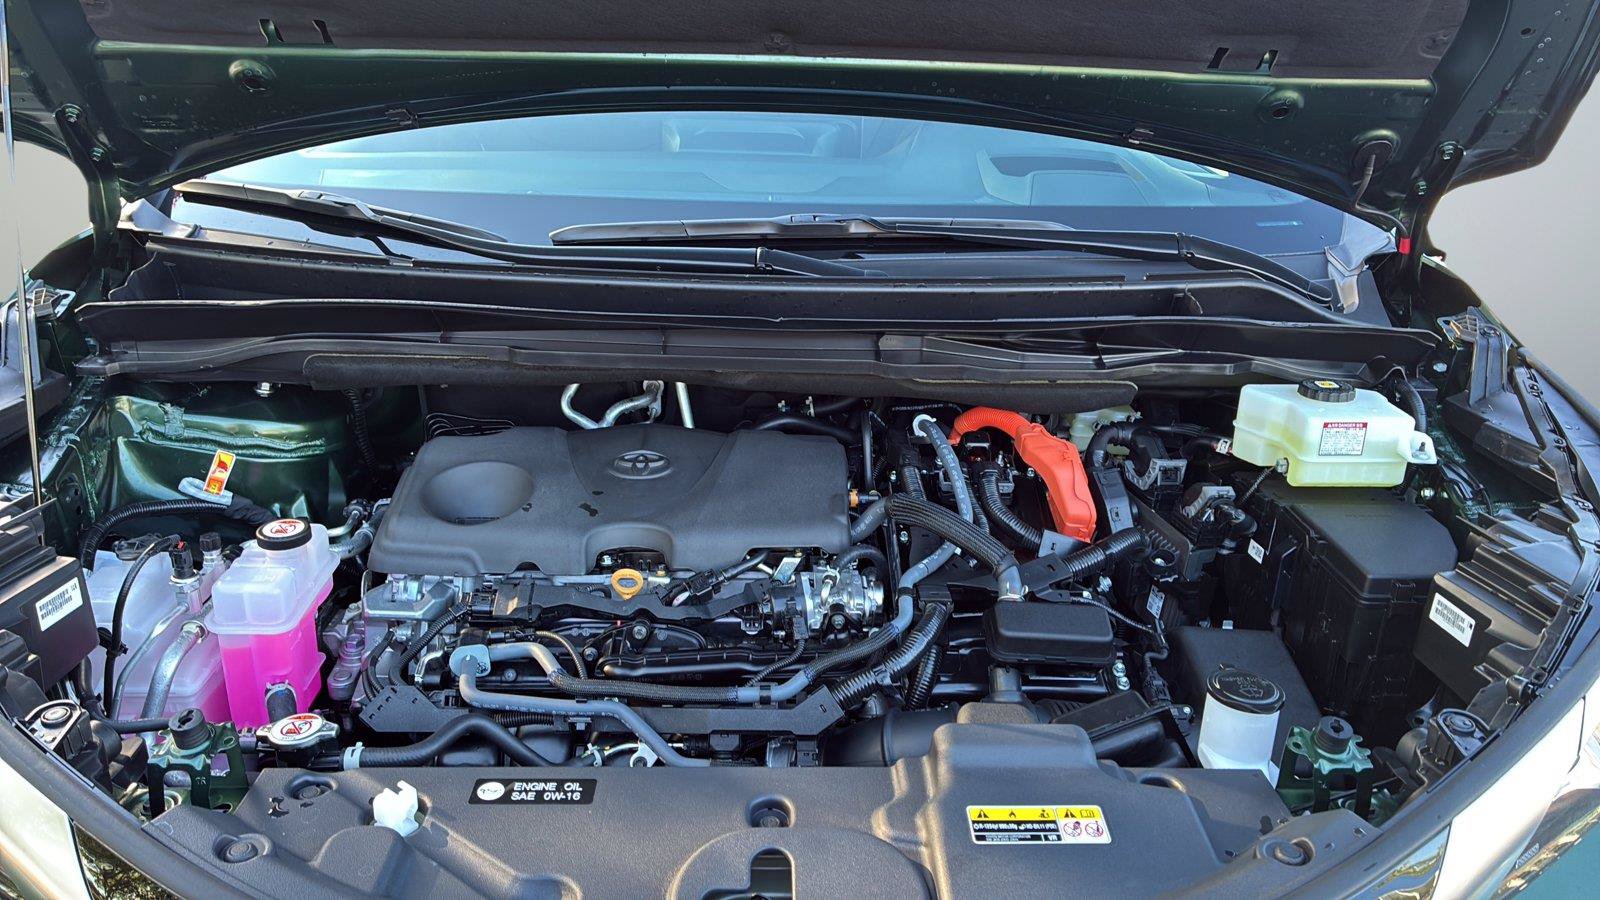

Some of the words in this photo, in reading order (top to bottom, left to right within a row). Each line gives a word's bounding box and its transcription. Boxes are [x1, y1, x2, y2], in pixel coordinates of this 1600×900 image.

[513, 782, 558, 791] ENGINE
[563, 782, 583, 791] OIL
[510, 792, 537, 801] SAE
[543, 792, 581, 801] 0W-16
